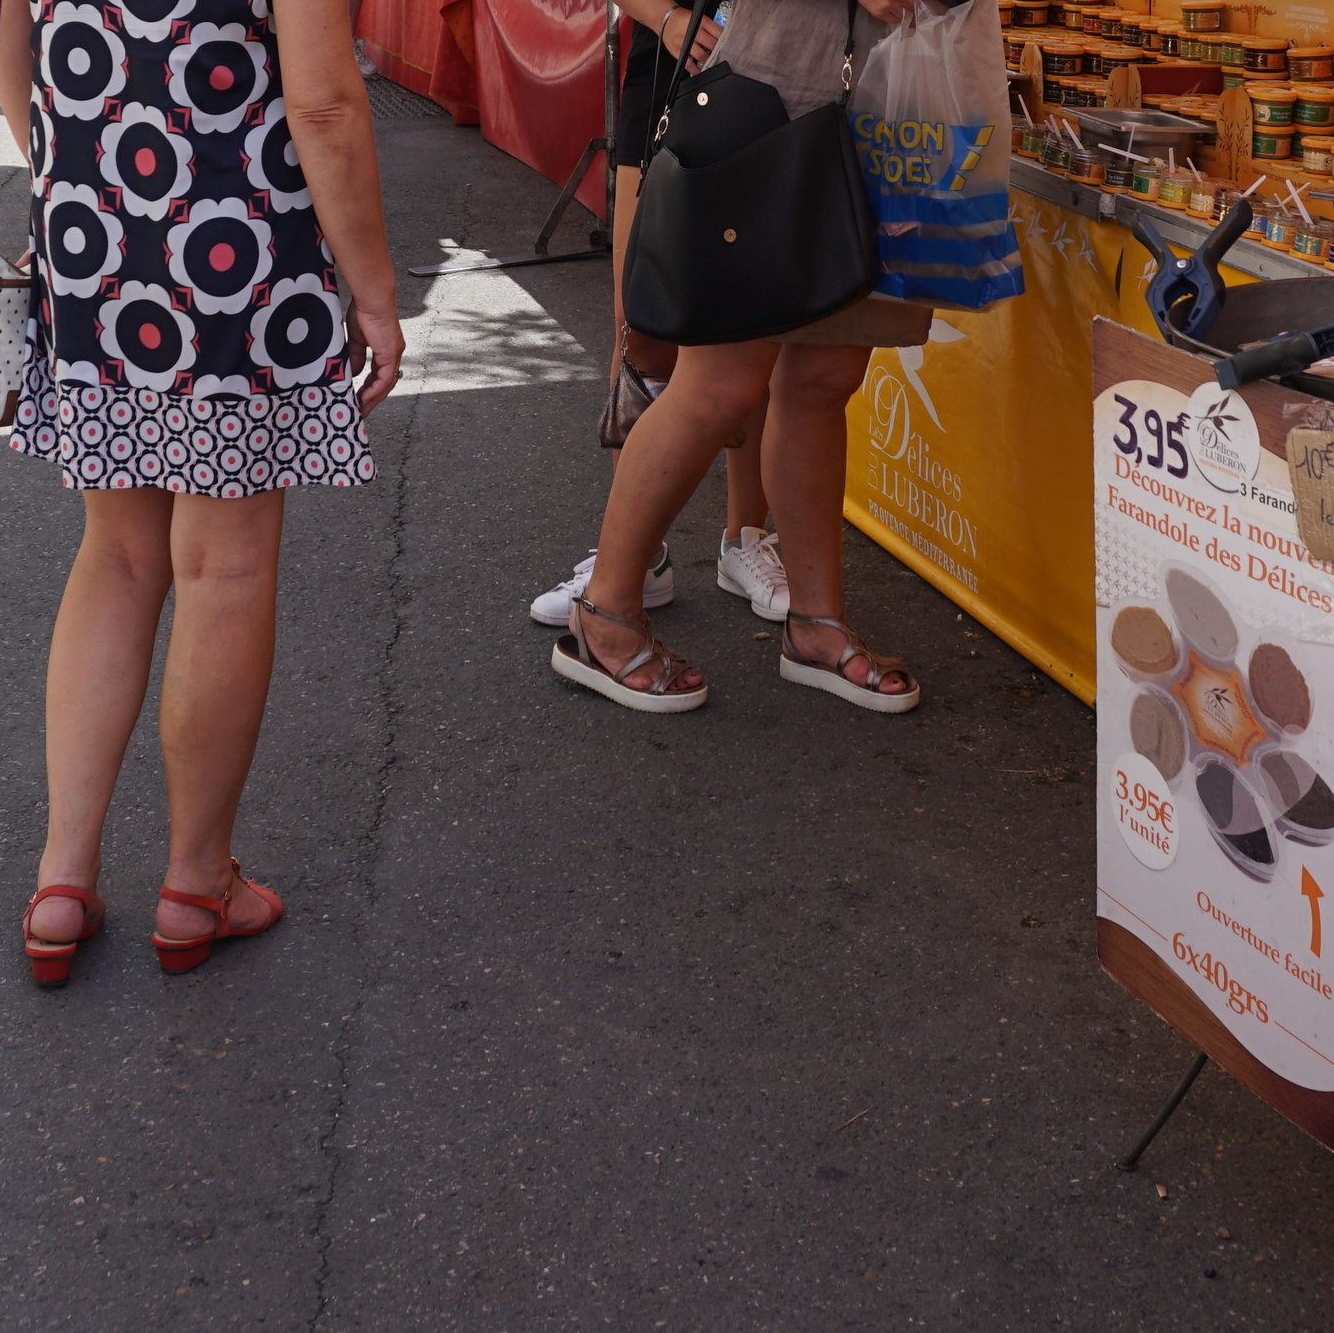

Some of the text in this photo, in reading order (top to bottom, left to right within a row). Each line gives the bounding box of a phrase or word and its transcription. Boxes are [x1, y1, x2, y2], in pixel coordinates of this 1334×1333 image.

[869, 364, 962, 502] Délices
[1205, 448, 1247, 474] LUBERON
[868, 498, 910, 543] PROVENCE
[881, 462, 979, 561] LUBERON
[1114, 452, 1218, 524] Découvrez
[1223, 505, 1242, 536] la
[1239, 482, 1297, 515] 3 Farand
[1107, 483, 1201, 553] Farandole
[1205, 537, 1241, 573] des
[1246, 552, 1333, 614] Délices
[1116, 769, 1175, 834] 3.95€
[1119, 804, 1170, 856] l'unité
[1172, 932, 1269, 1024] 6x40grs
[1196, 891, 1333, 1001] Ouverture facile
